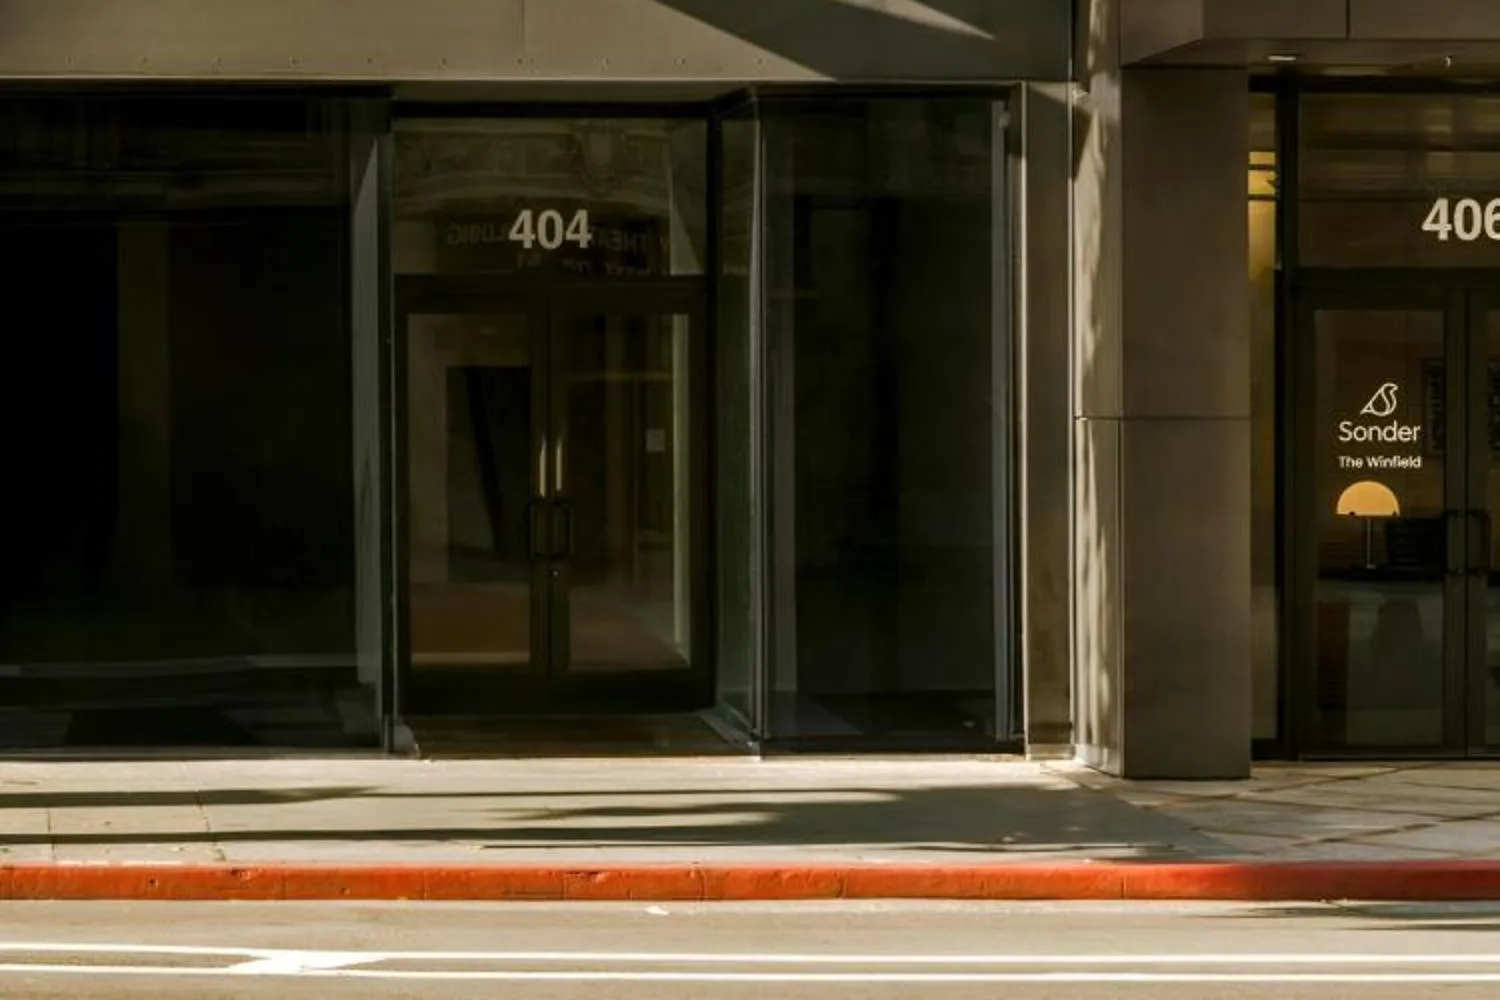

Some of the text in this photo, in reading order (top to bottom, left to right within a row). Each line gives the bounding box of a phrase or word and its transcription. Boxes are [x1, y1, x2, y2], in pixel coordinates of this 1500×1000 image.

[508, 209, 593, 250] 404
[1338, 419, 1421, 442] Sonder
[1338, 455, 1422, 469] The Winfield
